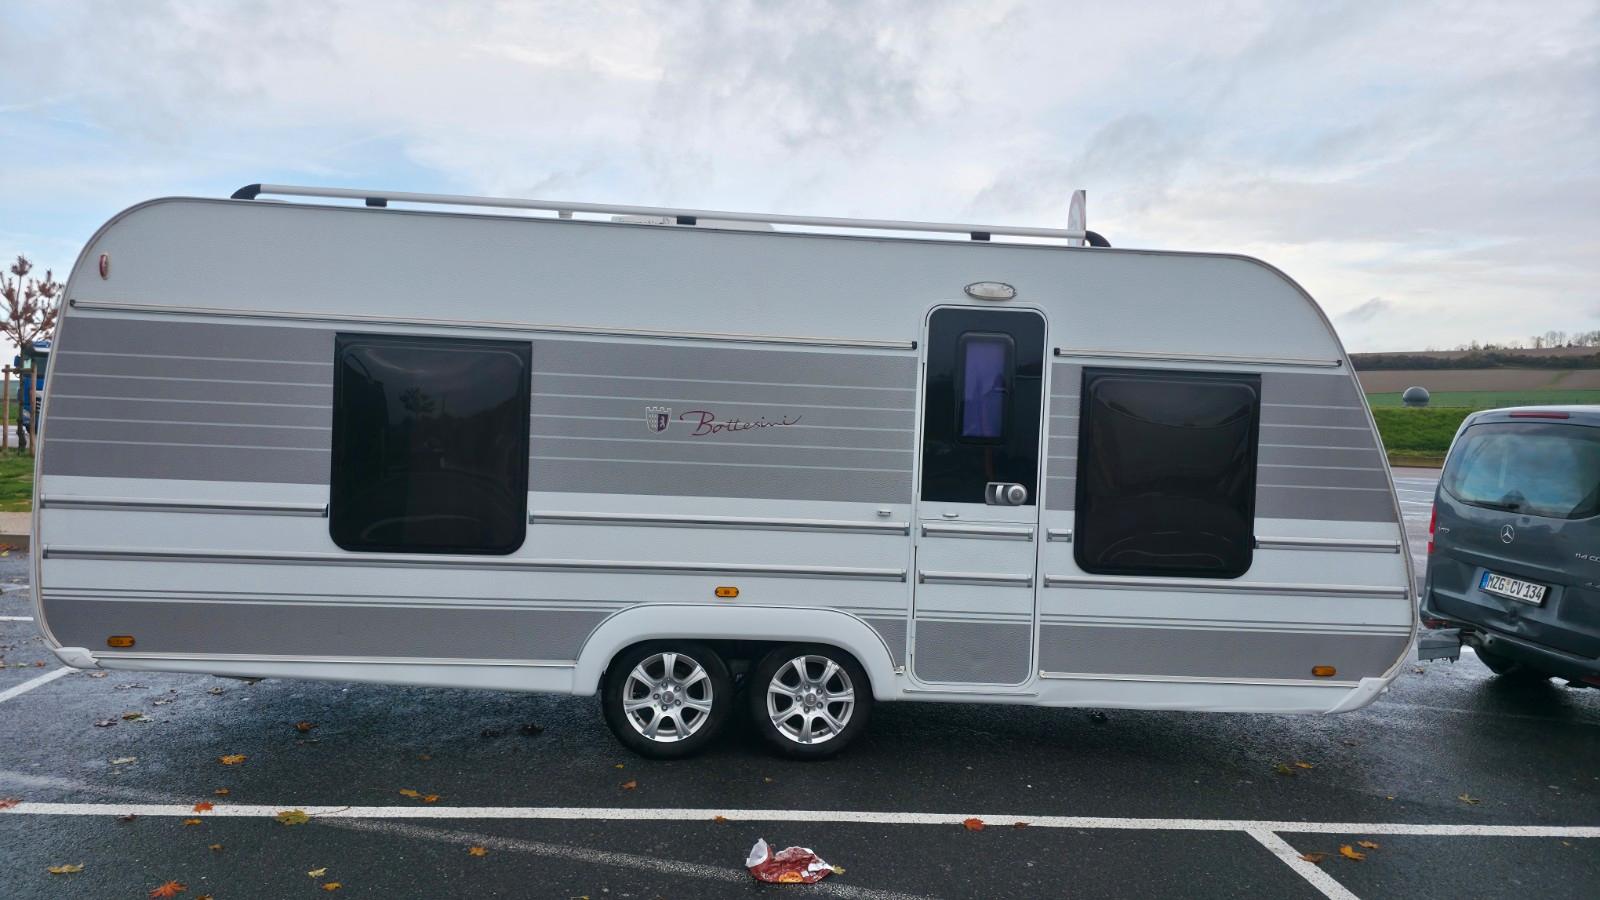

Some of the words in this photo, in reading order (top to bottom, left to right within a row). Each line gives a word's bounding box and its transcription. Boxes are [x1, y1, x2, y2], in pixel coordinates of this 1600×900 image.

[1487, 575, 1506, 591] MZG
[1509, 580, 1525, 596] CV
[1523, 584, 1543, 601] 134
